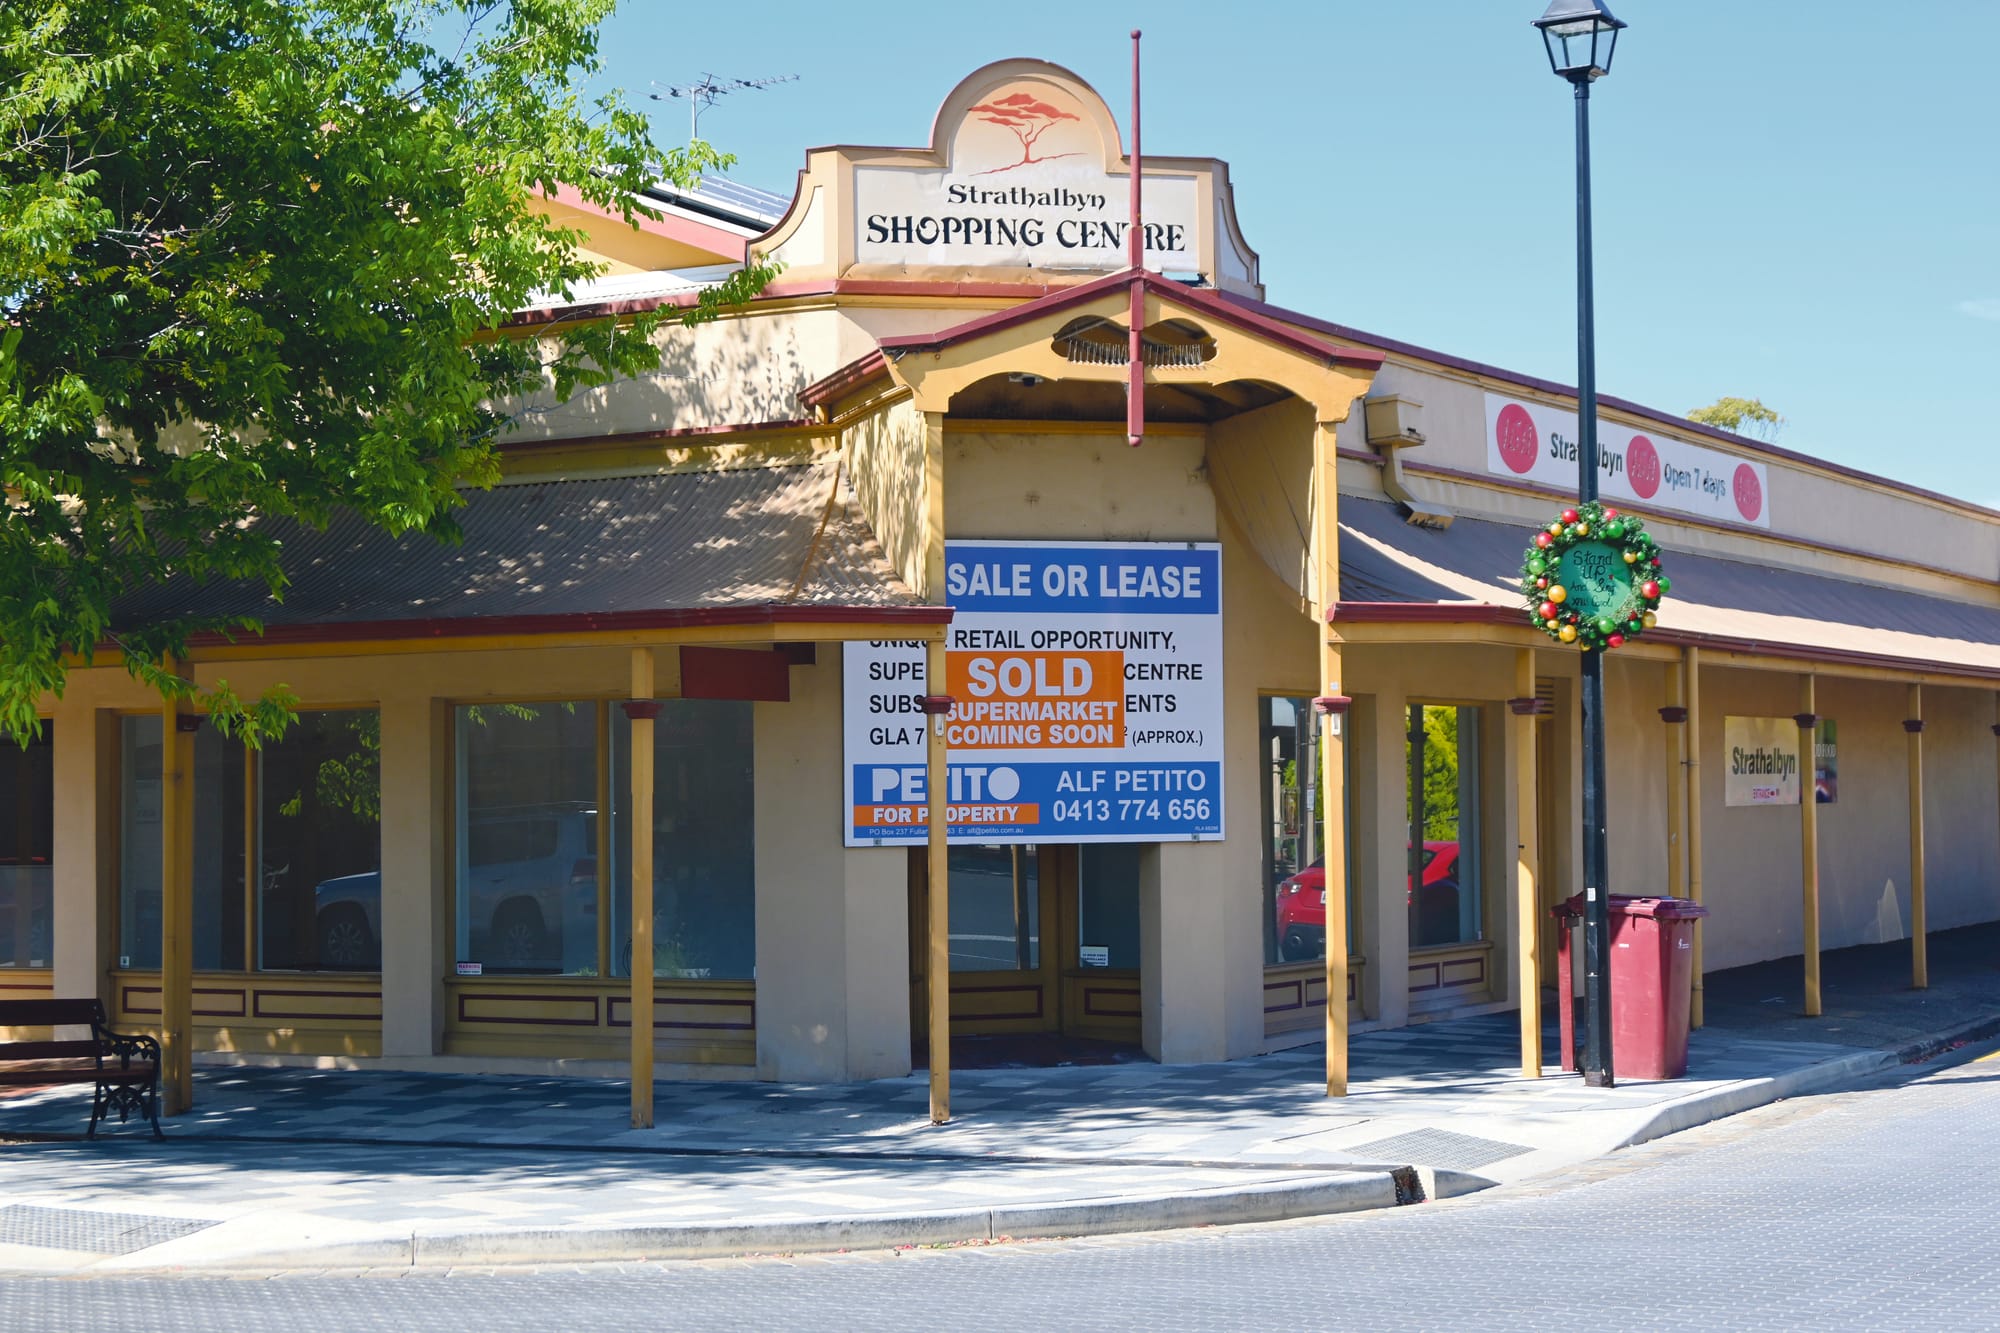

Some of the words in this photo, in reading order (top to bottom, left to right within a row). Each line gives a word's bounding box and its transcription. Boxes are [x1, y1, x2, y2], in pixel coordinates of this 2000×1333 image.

[948, 184, 1106, 211] Strathalbyn
[866, 214, 1045, 247] SHOPPING
[1550, 432, 1623, 477] Stralbyn
[1664, 463, 1692, 491] Open
[1694, 467, 1700, 490] 7
[1703, 470, 1727, 501] days
[1573, 550, 1613, 566] Stand
[947, 563, 1032, 596] SALE
[1042, 564, 1089, 597] OR
[1099, 565, 1201, 598] LEASE
[954, 629, 1025, 649] RETAIL
[1031, 630, 1176, 653] OPPORTUNITY,
[869, 661, 924, 680] SUPE
[1123, 663, 1203, 680] CENTRE
[967, 657, 1093, 697] SOLD
[869, 694, 925, 713] SUBS
[1125, 694, 1176, 712] ENTS
[946, 701, 1118, 722] SUPERMARKET
[869, 727, 910, 745] GLA
[914, 727, 925, 745] 7
[1132, 730, 1203, 747] (APPROX.)
[947, 725, 1041, 745] COMING
[1049, 724, 1113, 744] SOON
[1732, 746, 1796, 782] Strathalbyn
[872, 766, 1020, 802] PEITO
[1056, 770, 1106, 792] ALF
[1115, 769, 1206, 792] PETITO
[873, 808, 912, 823] FOR
[917, 806, 1019, 823] POPERTY
[1053, 799, 1110, 821] 0413
[1118, 799, 1160, 821] 774
[1168, 798, 1210, 820] 656
